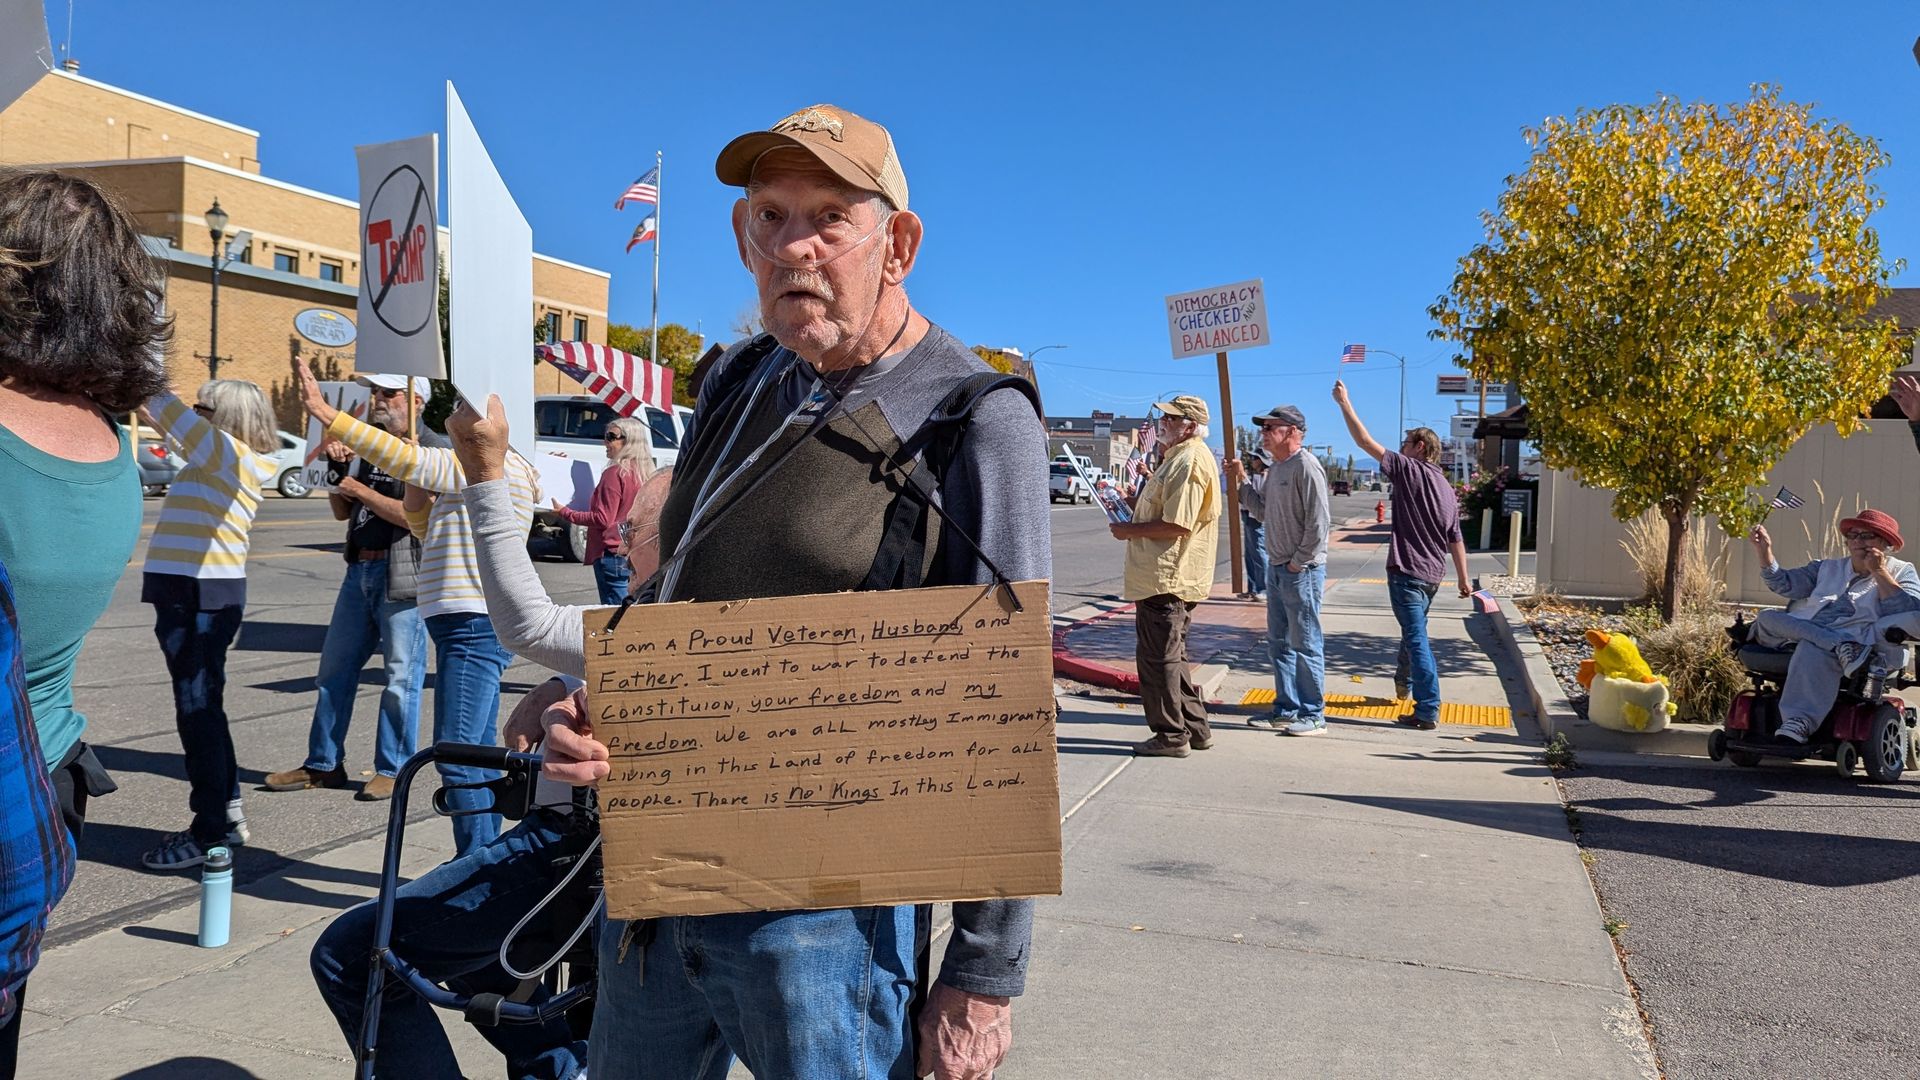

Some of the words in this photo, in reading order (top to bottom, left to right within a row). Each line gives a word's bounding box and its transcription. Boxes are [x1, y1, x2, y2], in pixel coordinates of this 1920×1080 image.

[368, 219, 426, 286] TRUMP
[1243, 302, 1256, 321] AND
[1183, 323, 1260, 352] BALANCED
[308, 469, 320, 486] NO
[598, 638, 614, 656] I
[625, 642, 655, 653] am
[689, 629, 753, 651] Proud
[975, 613, 1011, 629] and
[599, 670, 688, 692] Father.
[697, 664, 712, 682] I
[723, 662, 769, 677] went
[811, 659, 858, 672] war
[868, 652, 887, 669] to
[894, 648, 970, 667] defend
[987, 645, 1020, 660] the
[748, 696, 798, 713] your
[808, 685, 900, 704] freedom
[911, 681, 947, 697] and
[965, 683, 996, 699] my
[716, 726, 750, 744] We
[768, 728, 797, 739] are
[607, 769, 671, 785] Living
[686, 764, 706, 776] in
[718, 758, 758, 773] this
[769, 753, 822, 769] Land
[835, 750, 856, 765] of
[867, 747, 954, 764] freedom
[966, 741, 1000, 756] for
[691, 791, 749, 807] There
[764, 793, 778, 804] is
[831, 780, 879, 803] Kings
[889, 780, 909, 796] In
[916, 776, 954, 794] this
